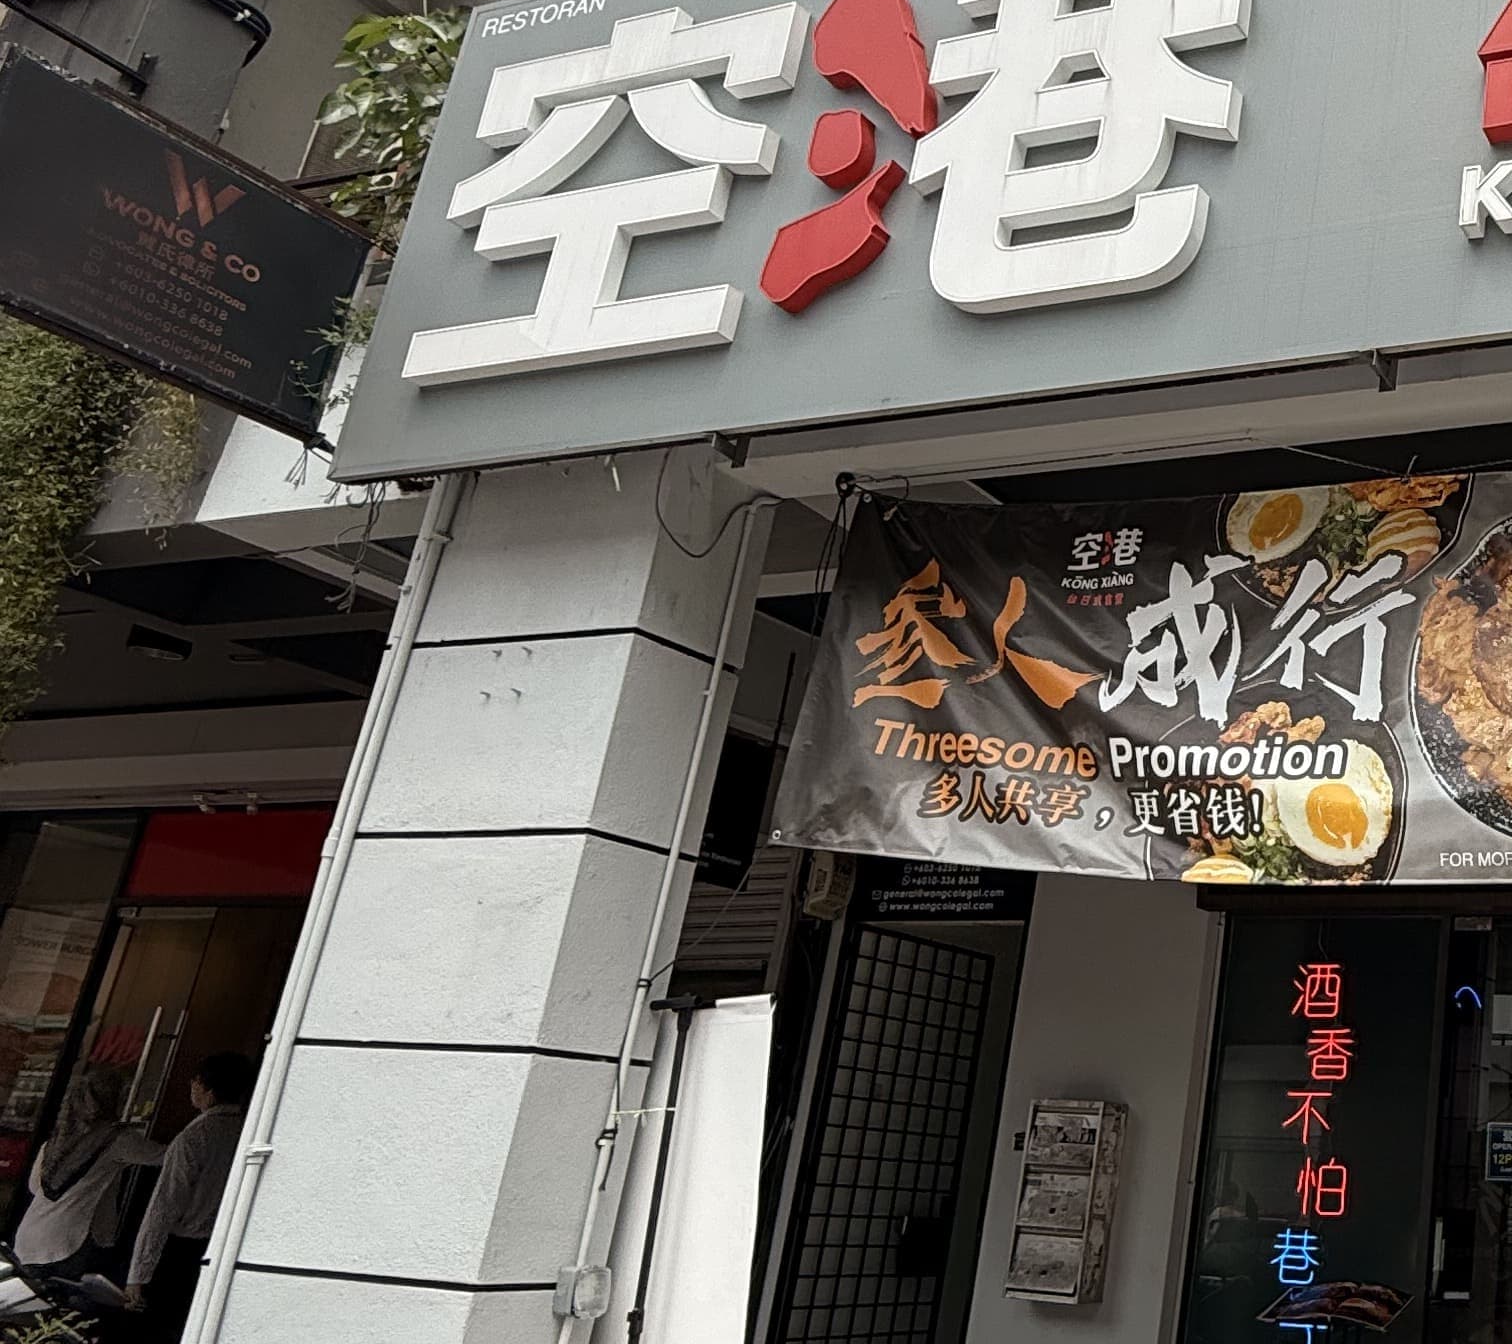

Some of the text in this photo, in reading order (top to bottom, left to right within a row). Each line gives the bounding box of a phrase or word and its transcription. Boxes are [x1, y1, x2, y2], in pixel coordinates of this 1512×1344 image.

[103, 188, 261, 284] WONG & CO
[1101, 570, 1134, 588] XIÀNG
[873, 717, 1346, 780] Threesome Promotion
[1439, 852, 1473, 868] FOR
